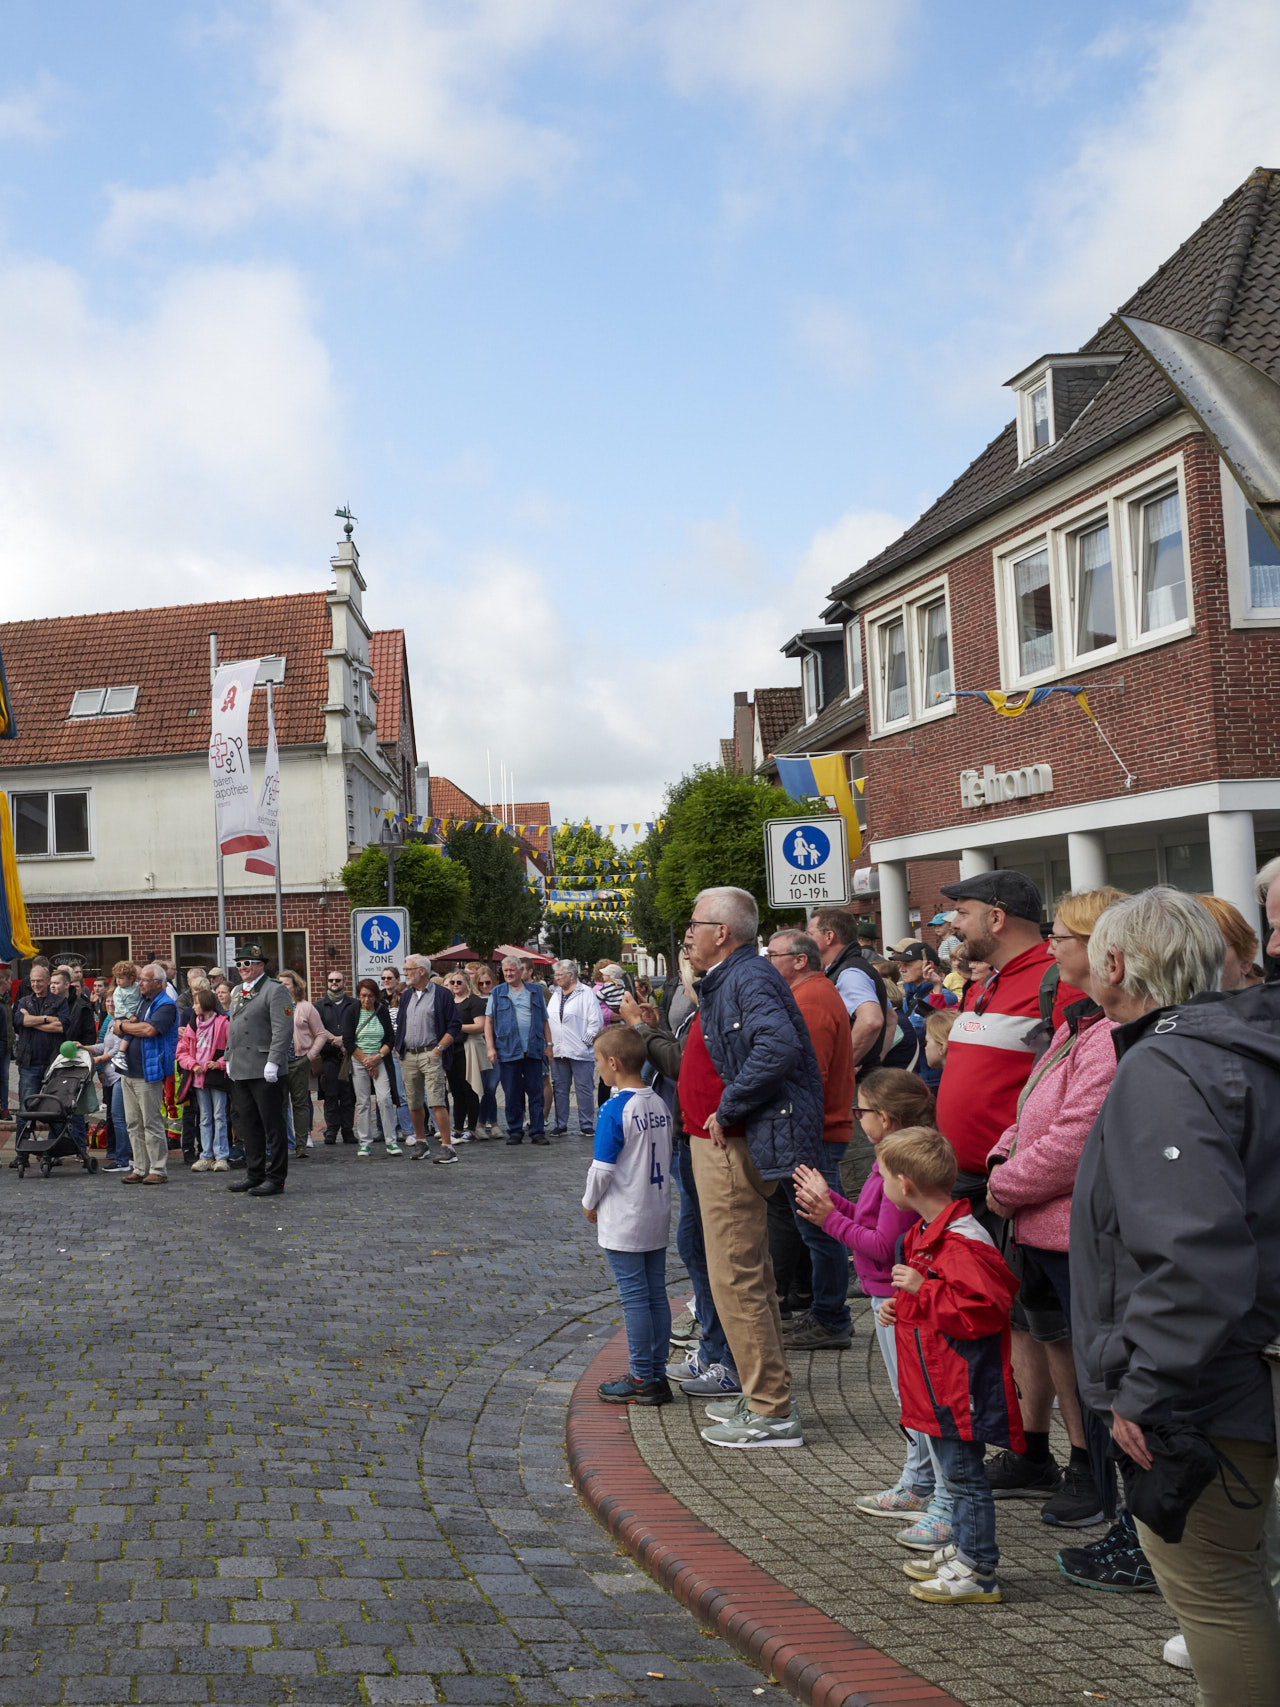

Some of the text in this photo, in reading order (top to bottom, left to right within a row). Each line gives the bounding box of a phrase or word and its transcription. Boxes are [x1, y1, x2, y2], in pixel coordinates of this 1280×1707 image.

[790, 873, 826, 885] ZONE
[369, 955, 393, 964] ZONE
[650, 1142, 664, 1190] 4
